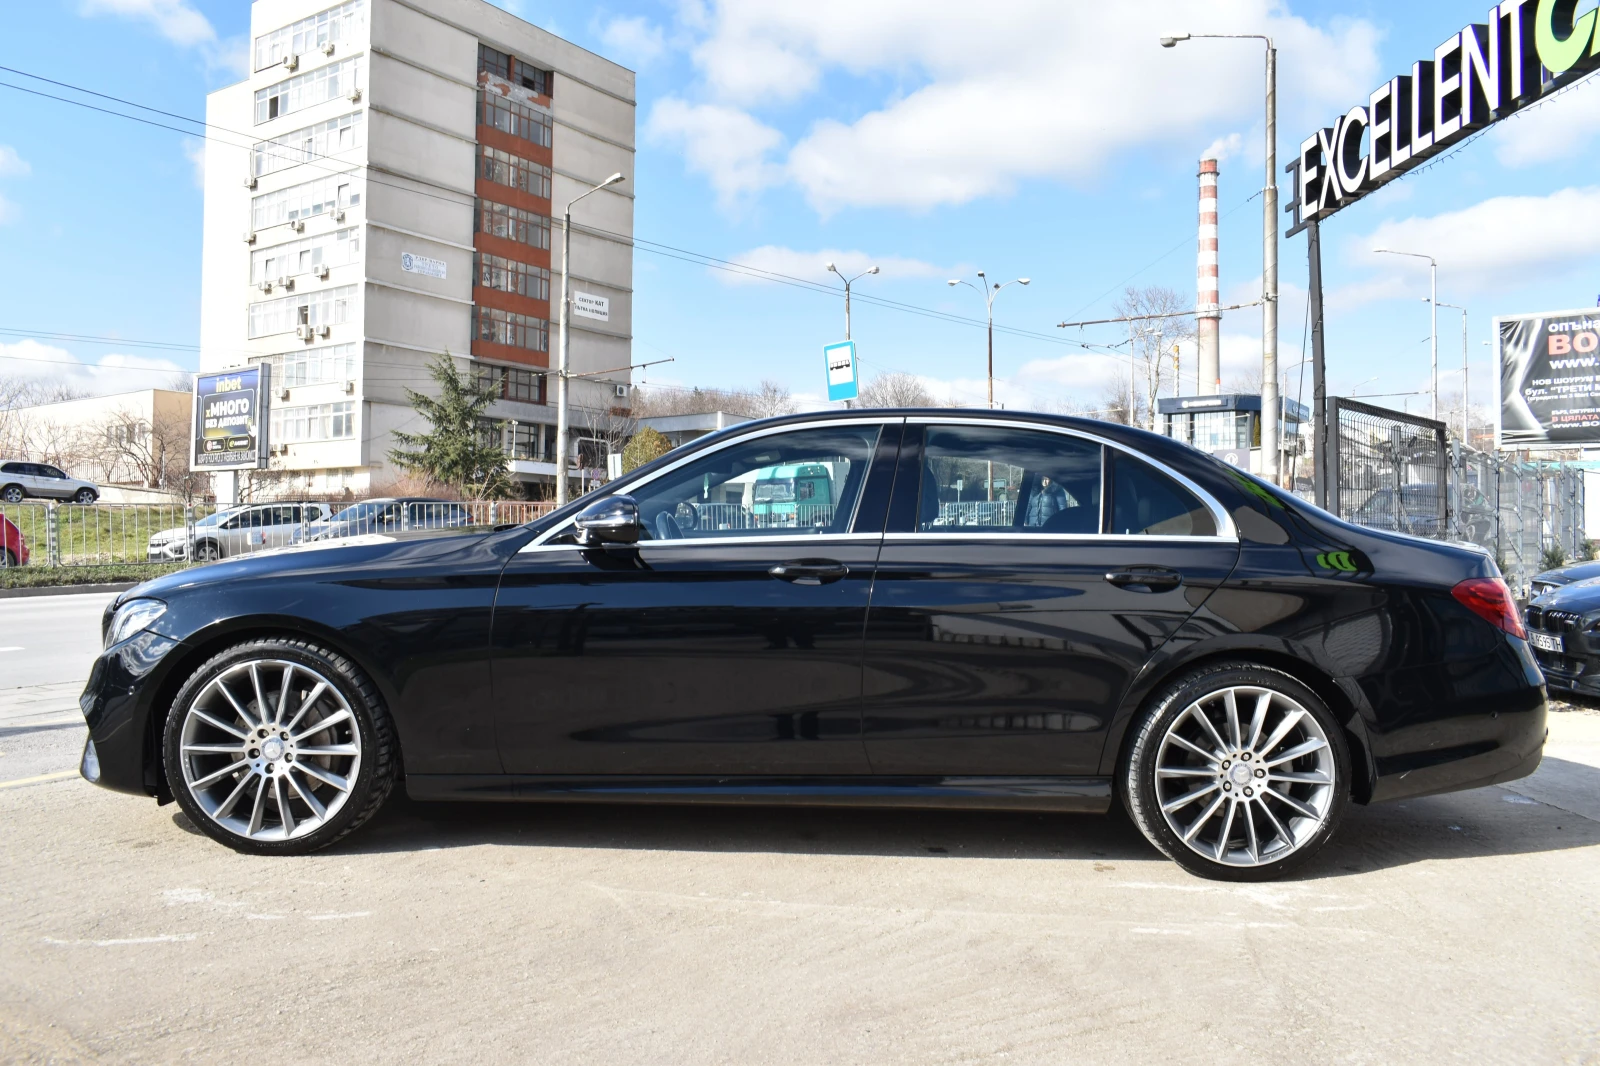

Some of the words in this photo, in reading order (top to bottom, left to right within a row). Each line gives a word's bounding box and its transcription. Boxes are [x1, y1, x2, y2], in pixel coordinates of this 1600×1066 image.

[216, 376, 242, 392] inbet
[1554, 376, 1594, 384] ШОУРУМ
[1524, 388, 1548, 396] бул.
[206, 418, 218, 428] БЕЗ
[218, 414, 248, 428] ДЕПОЗИТ
[1561, 414, 1599, 422] ЦЯЛАТА
